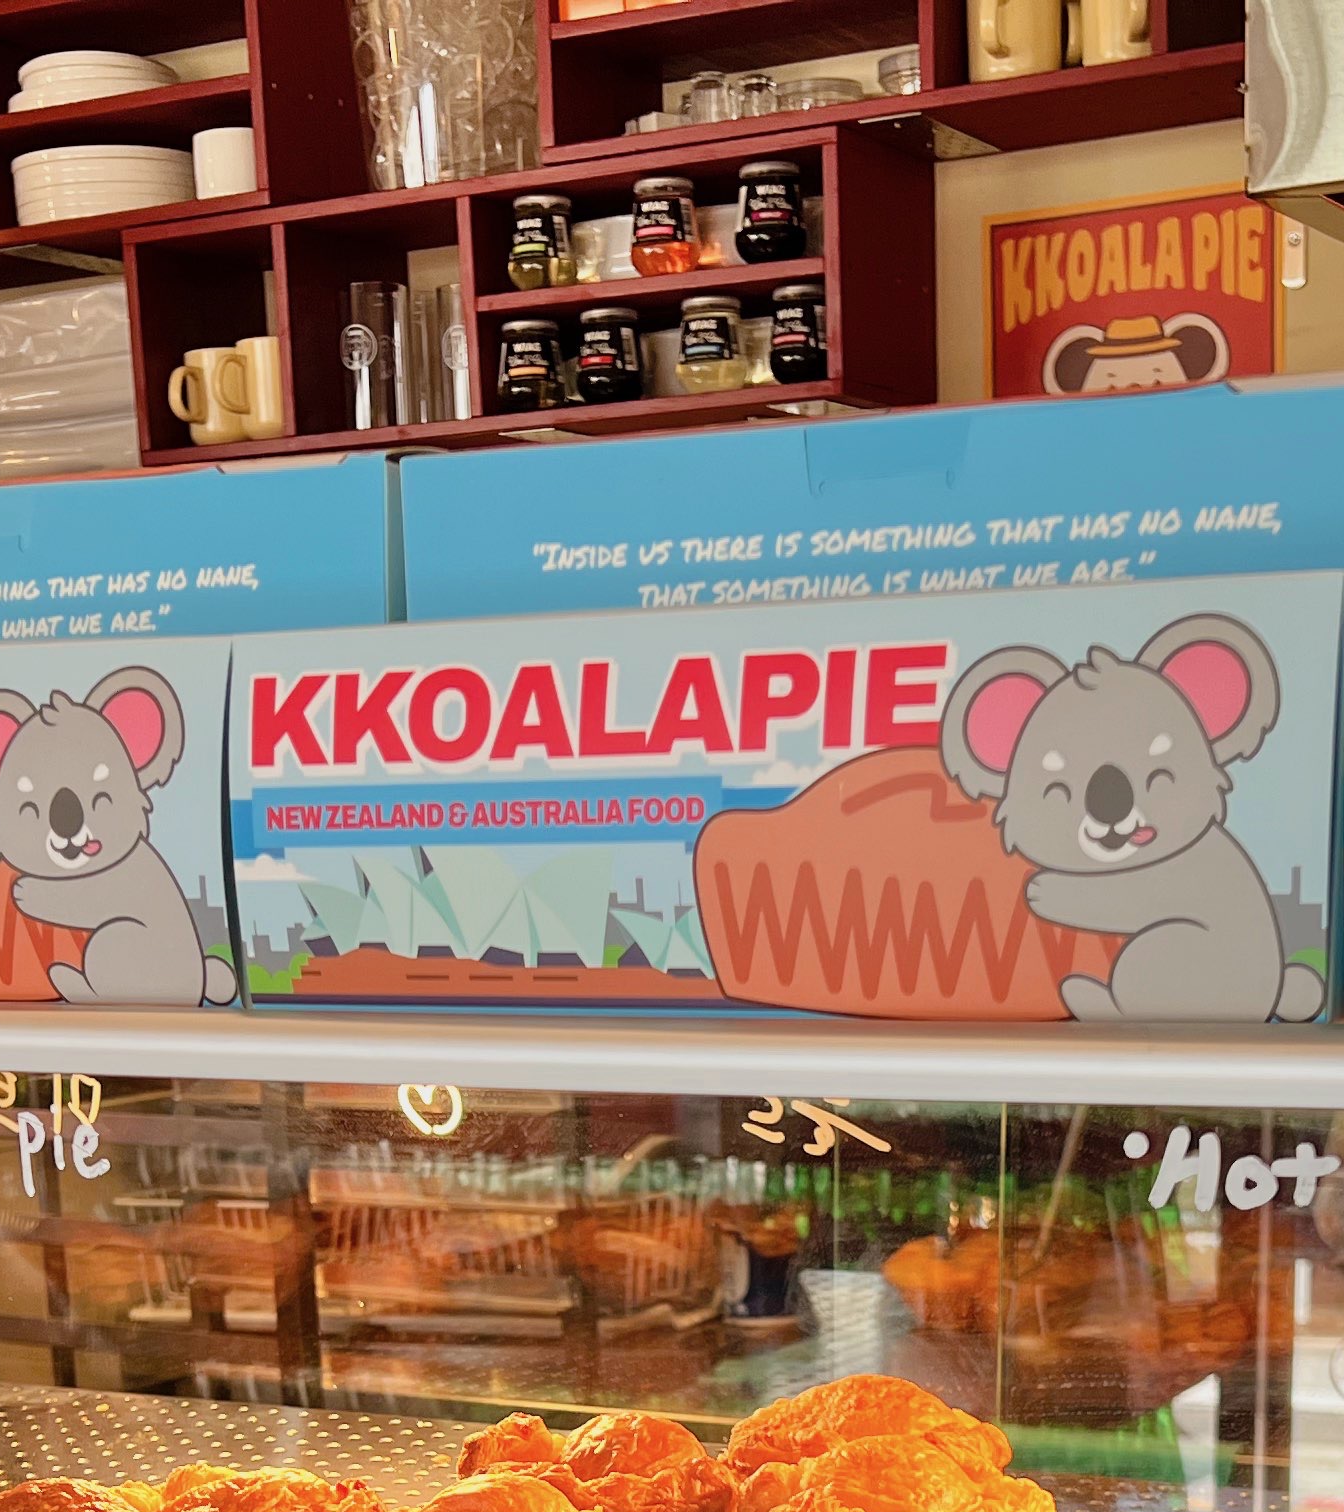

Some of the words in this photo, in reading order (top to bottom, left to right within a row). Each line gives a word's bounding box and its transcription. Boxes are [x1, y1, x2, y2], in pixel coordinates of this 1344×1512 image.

[1000, 216, 1186, 333] KKOALA
[1191, 204, 1266, 303] PIE
[639, 539, 673, 566] US
[680, 534, 764, 564] THERE
[775, 530, 803, 559] IS
[810, 521, 977, 557] SOMETHING
[986, 515, 1064, 548] THAT
[1069, 510, 1132, 542] HAS
[1138, 506, 1183, 537] NO
[47, 574, 103, 600] THAT
[107, 570, 153, 595] HAS
[156, 568, 189, 592] NO
[638, 581, 706, 609] THAT
[712, 572, 871, 605] SOMETHING
[882, 569, 913, 595] IS
[919, 563, 1006, 593] WHAT
[1012, 560, 1060, 588] WE
[1, 615, 64, 639] WHAT
[69, 612, 103, 636] WE
[250, 644, 948, 768] KKOALAPIE
[448, 801, 469, 828] &
[471, 798, 624, 828] AUSTRALIA
[627, 795, 706, 825] FOOD
[1147, 1124, 1342, 1212] Hot
